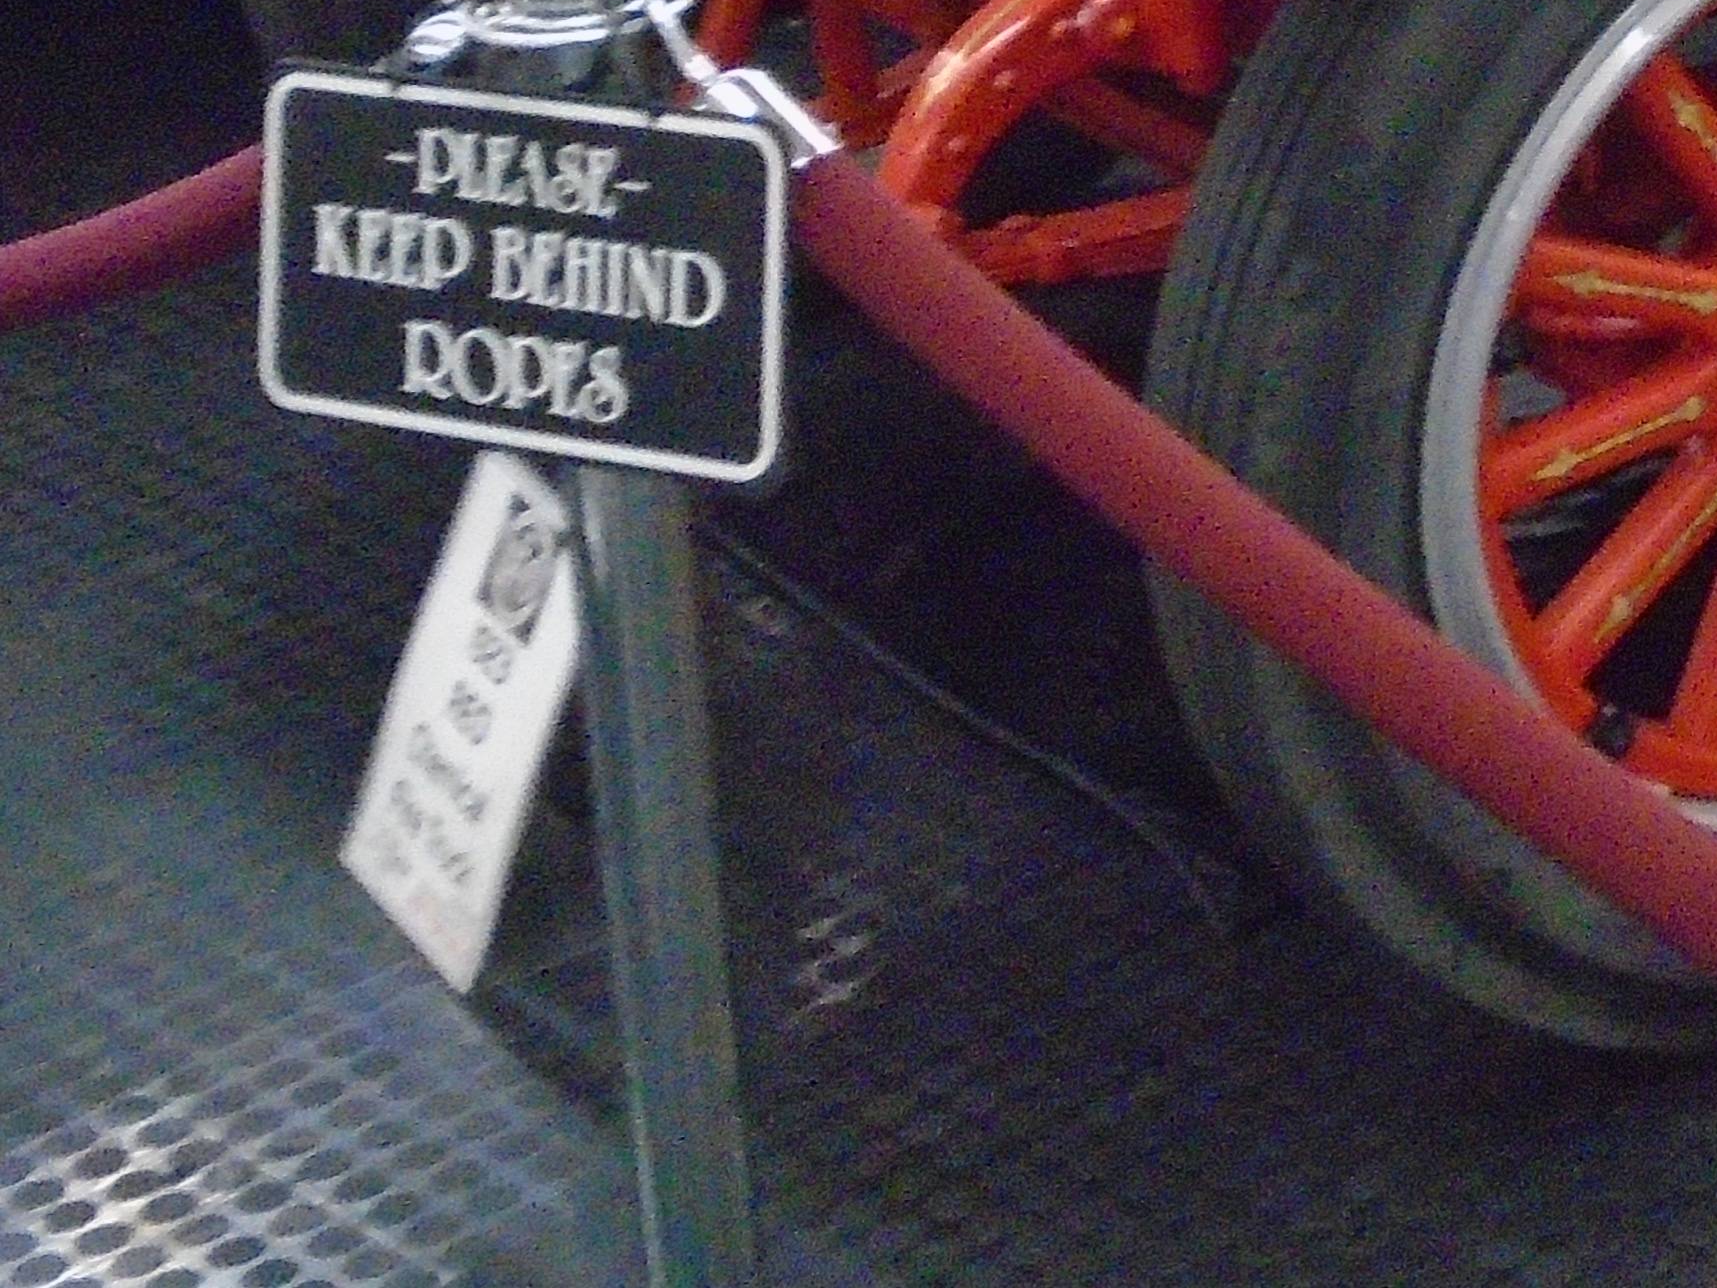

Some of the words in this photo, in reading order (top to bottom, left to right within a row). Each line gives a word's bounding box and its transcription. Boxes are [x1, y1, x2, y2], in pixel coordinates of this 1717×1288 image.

[311, 203, 475, 290] KEEP
[489, 227, 728, 328] BEHIND
[402, 320, 631, 422] ROPES
